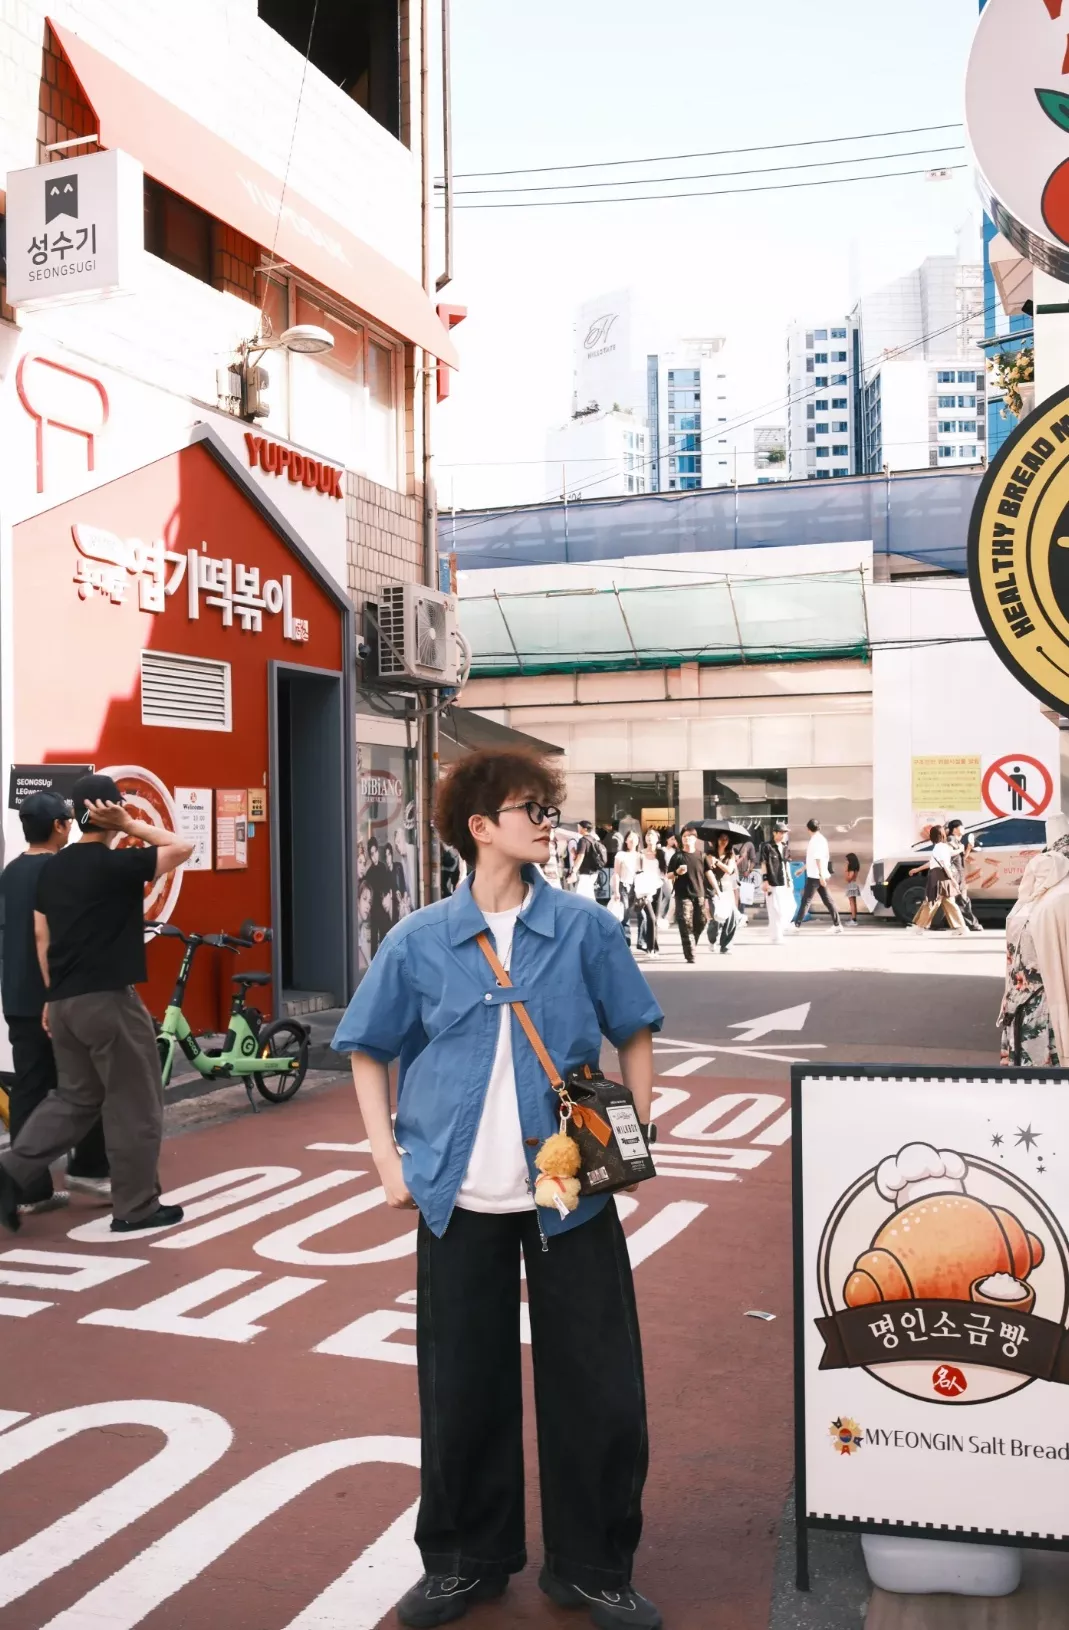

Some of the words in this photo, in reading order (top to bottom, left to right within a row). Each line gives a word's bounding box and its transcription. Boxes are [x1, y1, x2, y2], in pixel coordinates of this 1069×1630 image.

[27, 224, 96, 265] 성수기
[28, 260, 96, 281] SEONGSUGI
[244, 432, 343, 499] YUPDDUK
[997, 437, 1056, 518] BREAD
[125, 537, 293, 639] 엽기떡볶이
[992, 522, 1036, 639] HEALTHY
[16, 778, 53, 788] SEONGSUgi
[182, 803, 204, 811] Welcome
[616, 1125, 638, 1135] MILKBOX
[868, 1308, 1029, 1357] 명인소금빵
[934, 1366, 964, 1393] 名人
[865, 1428, 964, 1452] MYEONGIN
[968, 1436, 1006, 1456] Salt
[1011, 1439, 1069, 1461] Bread
